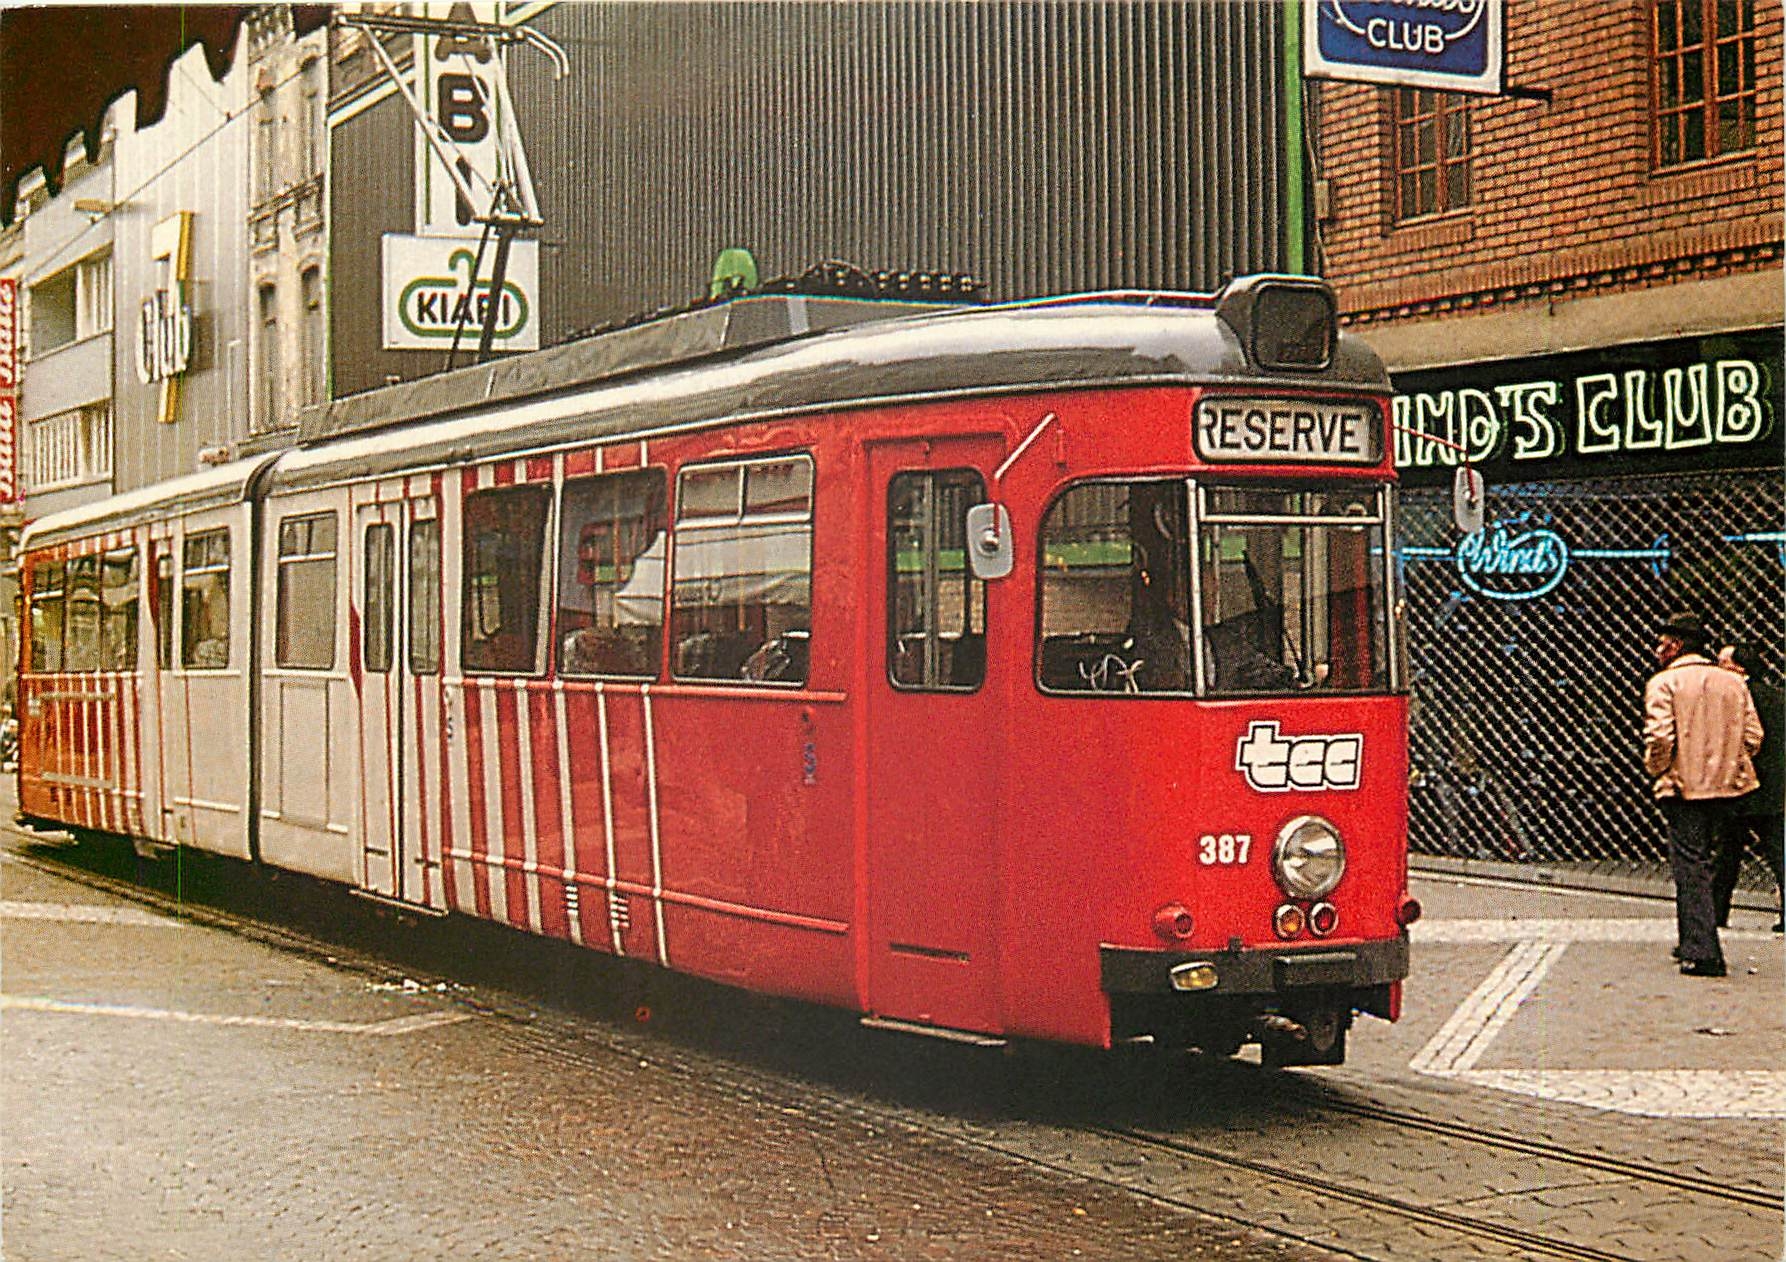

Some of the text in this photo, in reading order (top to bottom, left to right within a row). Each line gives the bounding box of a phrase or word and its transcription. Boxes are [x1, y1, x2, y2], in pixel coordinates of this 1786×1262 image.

[1367, 18, 1444, 53] CLUB
[1576, 360, 1763, 454] CLUB
[1200, 407, 1362, 453] RESERVE
[1199, 834, 1252, 865] 387
